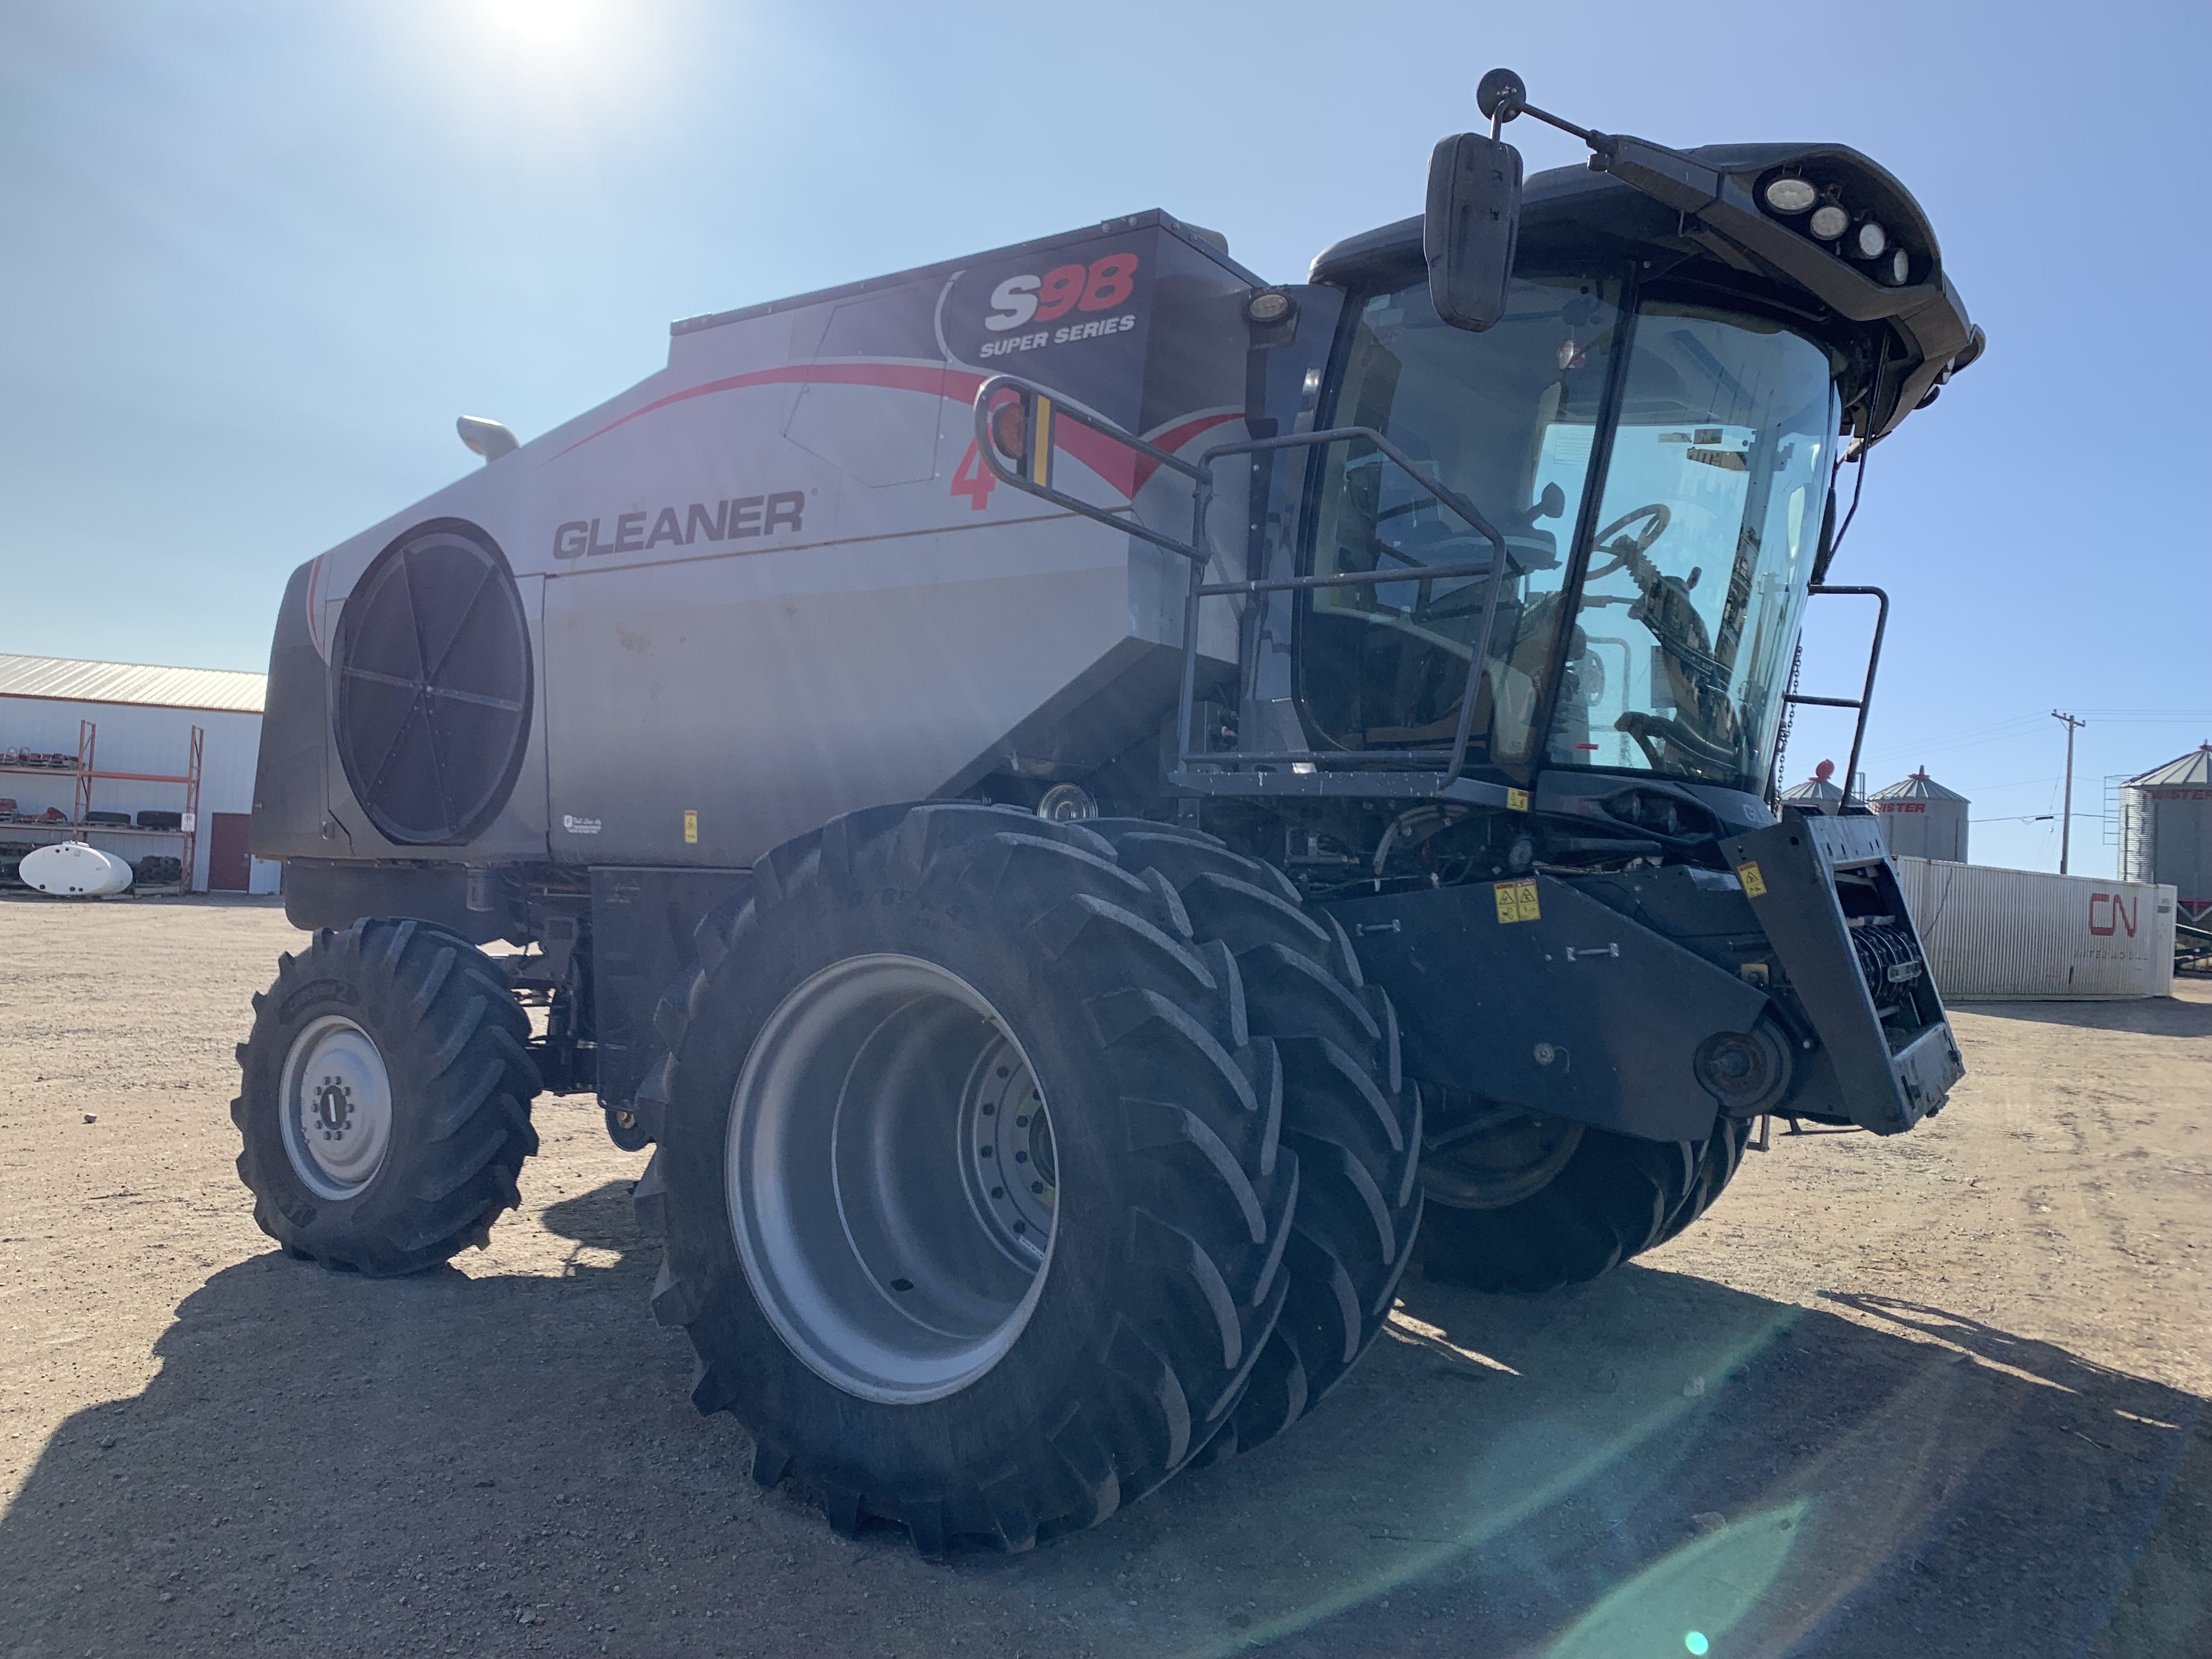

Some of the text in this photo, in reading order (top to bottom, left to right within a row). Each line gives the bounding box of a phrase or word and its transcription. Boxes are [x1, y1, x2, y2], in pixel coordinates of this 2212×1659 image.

[984, 253, 1138, 331] S98
[979, 315, 1137, 358] SUPER SERIES
[553, 490, 805, 560] GLEANER
[2089, 893, 2137, 938] CN
